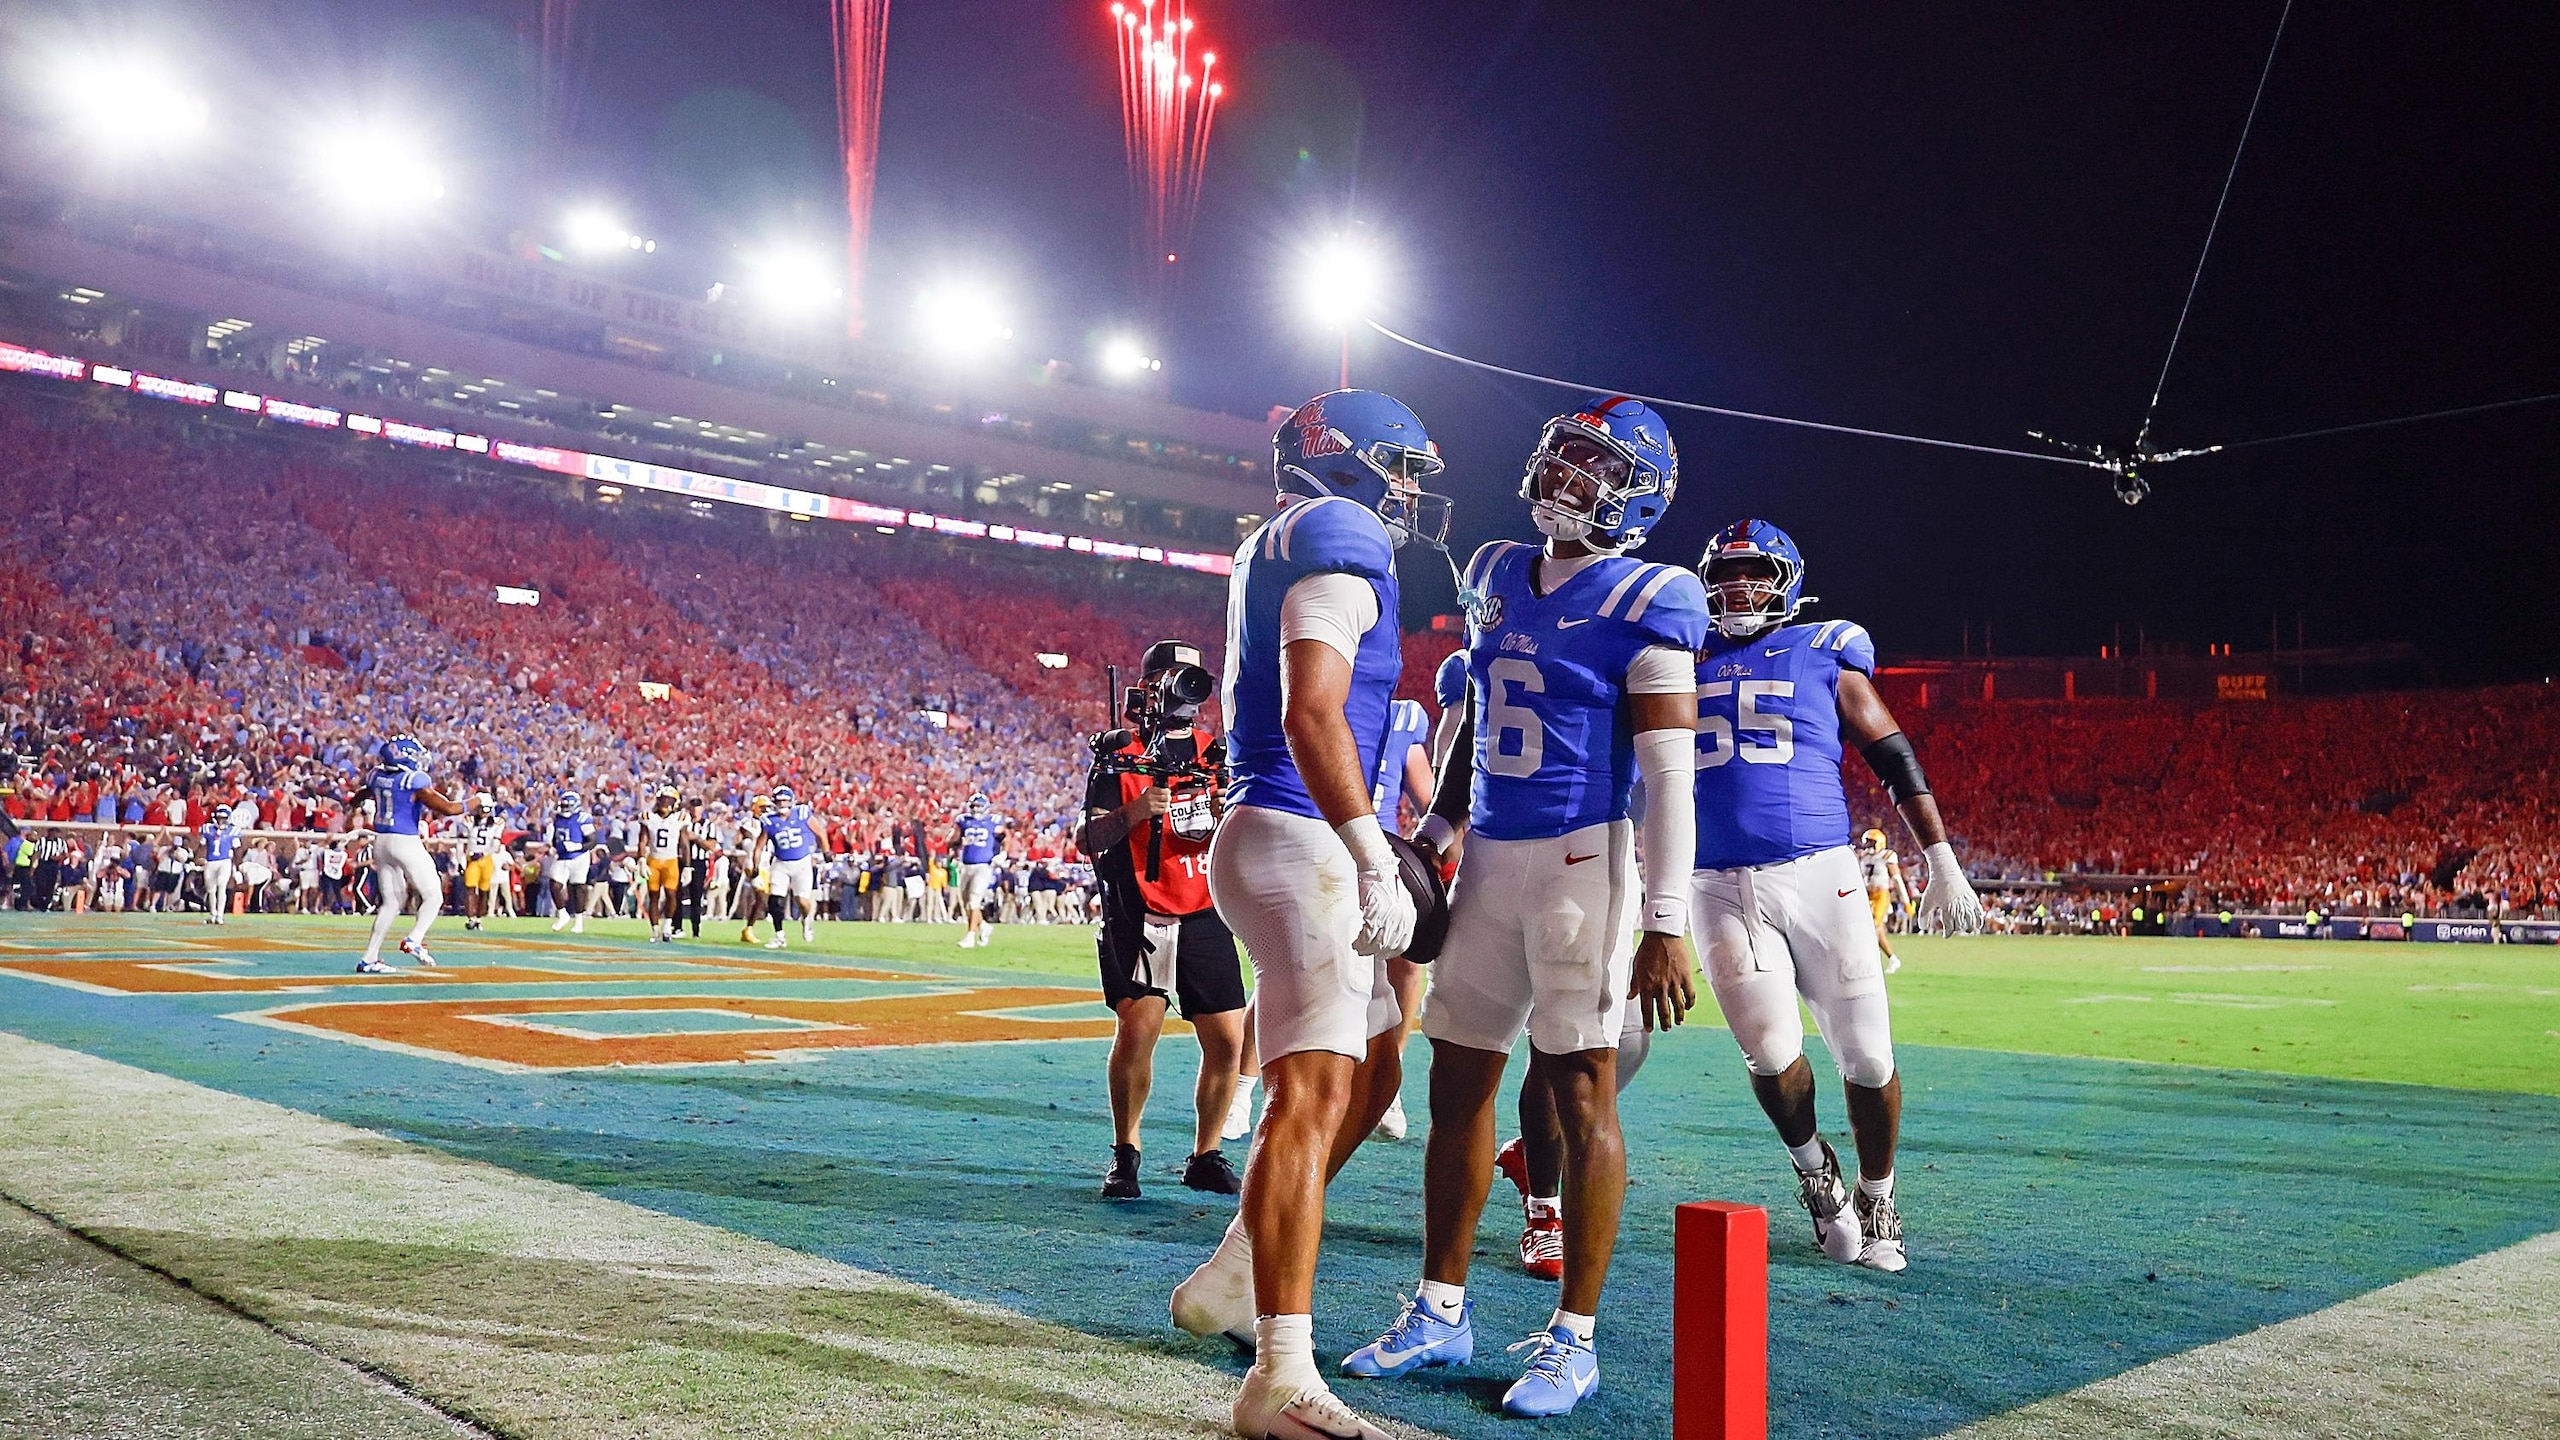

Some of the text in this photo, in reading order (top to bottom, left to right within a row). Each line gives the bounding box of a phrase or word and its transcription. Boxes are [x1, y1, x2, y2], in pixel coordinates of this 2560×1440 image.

[1295, 400, 1325, 428] Ole
[1301, 424, 1346, 460] Miss
[1486, 656, 1545, 778] 6
[1694, 680, 1795, 771] 55
[1170, 800, 1211, 818] COLLEGE
[212, 839, 221, 857] 1
[476, 828, 487, 846] 5
[656, 828, 669, 848] 6
[1179, 852, 1209, 879] 18
